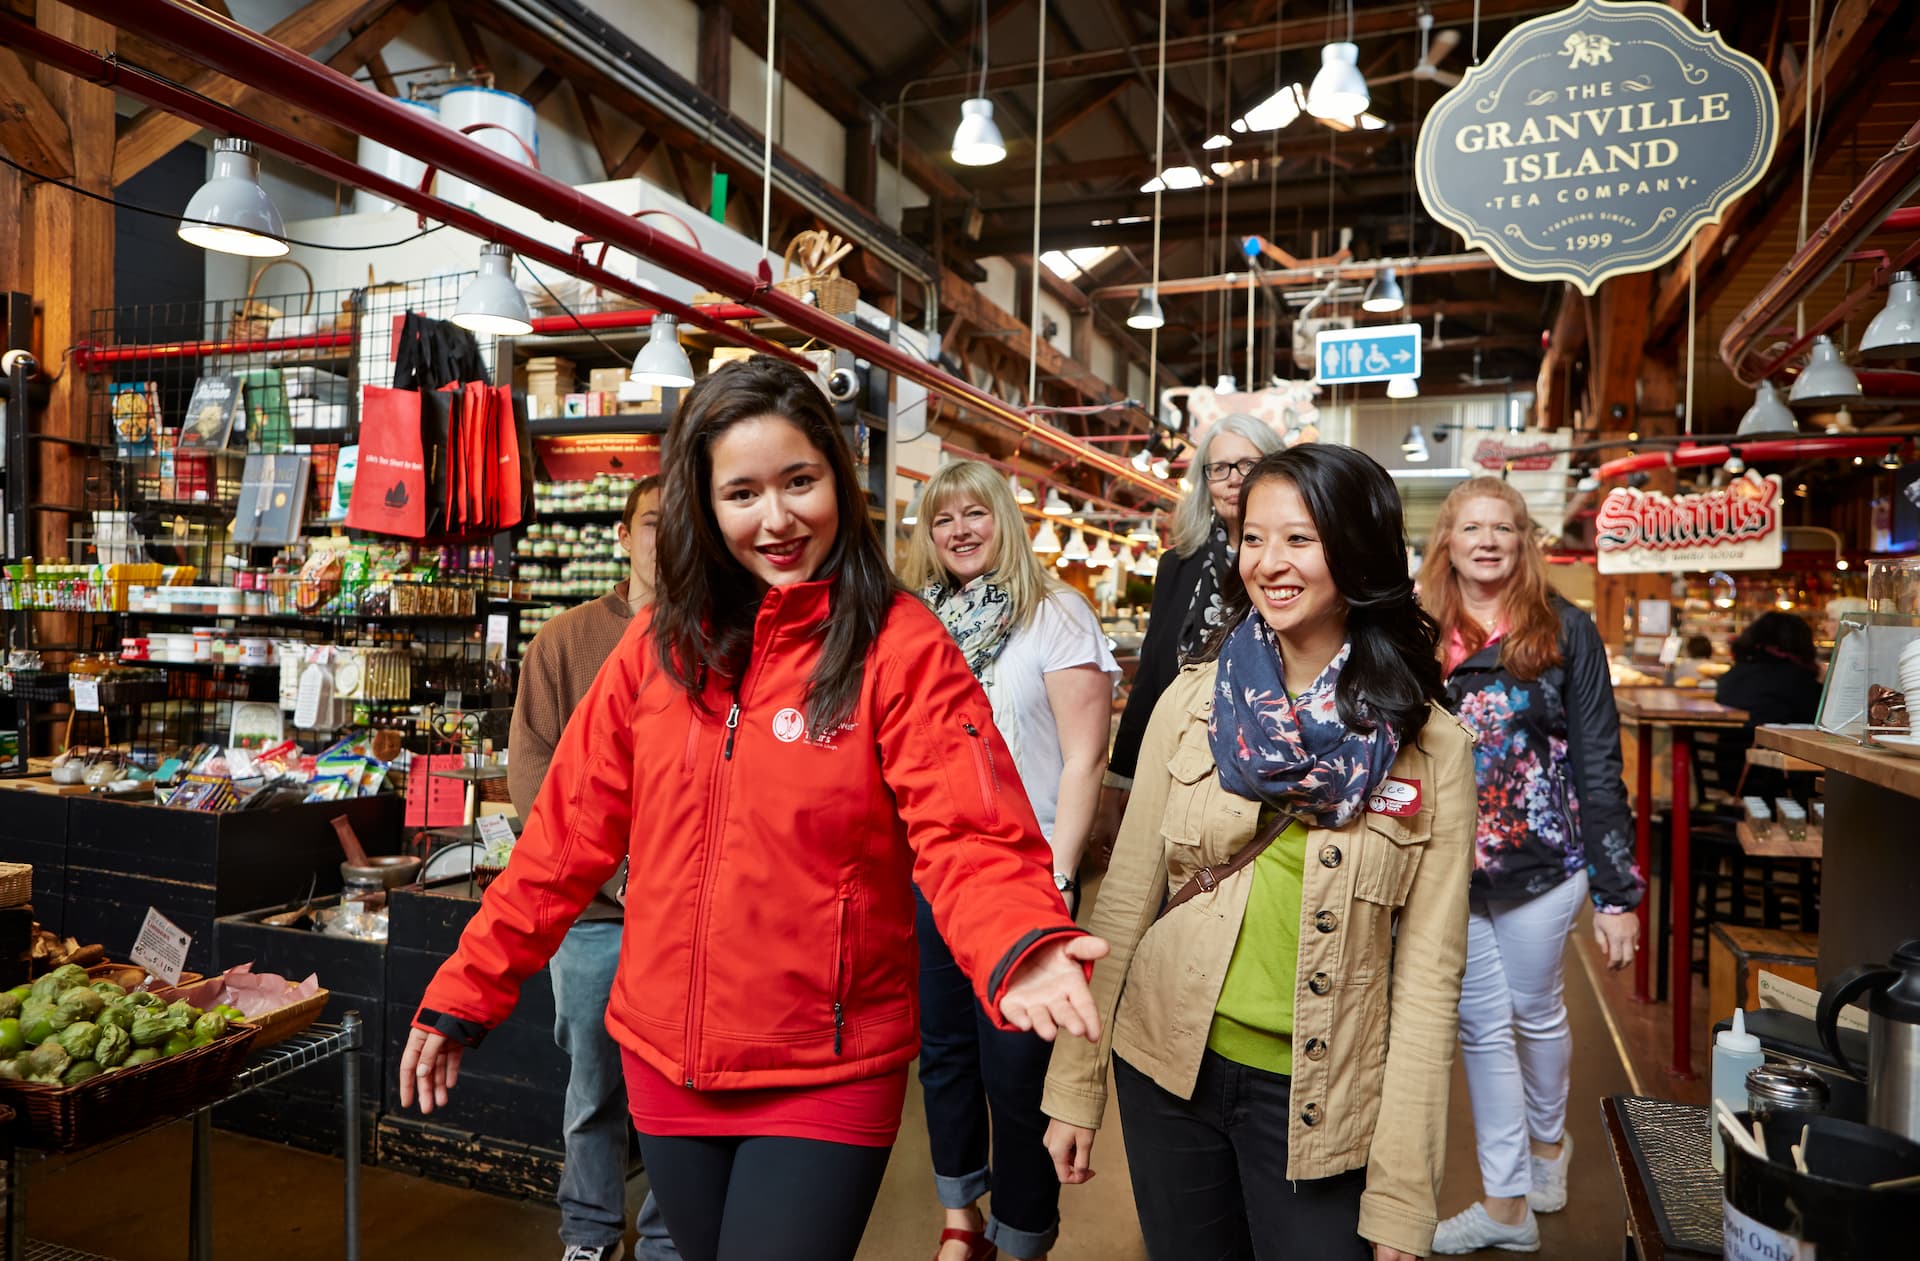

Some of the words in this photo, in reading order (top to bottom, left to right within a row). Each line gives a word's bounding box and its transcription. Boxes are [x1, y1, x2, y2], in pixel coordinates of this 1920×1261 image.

[1566, 81, 1613, 101] THE
[1455, 92, 1731, 154] GRANVILLE
[1502, 138, 1679, 185] ISLAND
[1494, 193, 1541, 210] TEA
[1557, 176, 1688, 203] COMPANY
[1565, 232, 1613, 252] 1999
